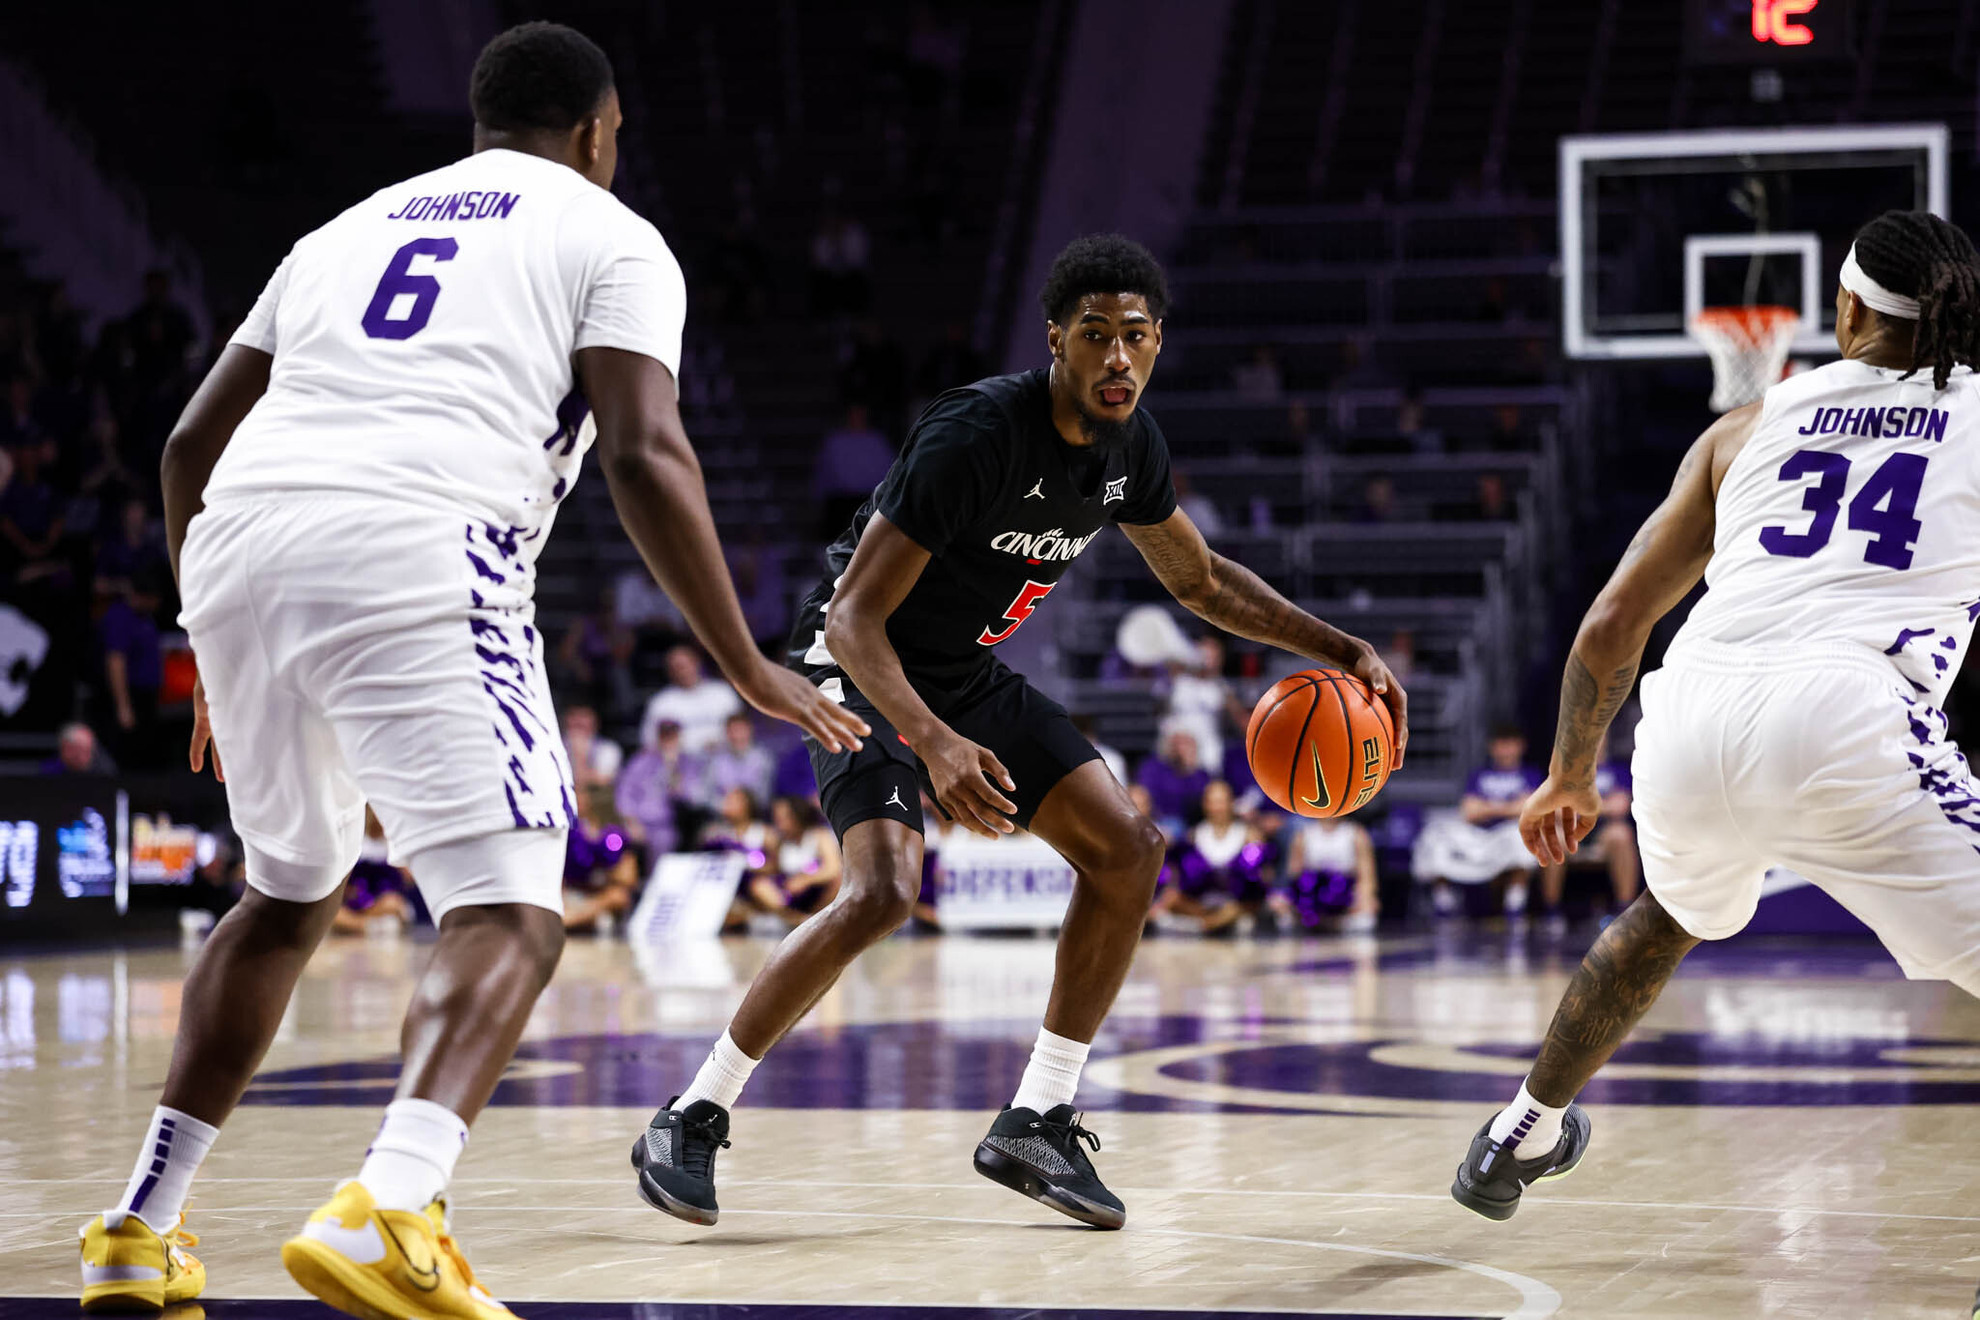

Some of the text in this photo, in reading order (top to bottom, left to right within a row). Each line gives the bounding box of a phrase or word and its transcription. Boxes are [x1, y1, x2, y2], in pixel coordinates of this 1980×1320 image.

[387, 191, 521, 221] JOHNSON
[361, 237, 459, 340] 6
[1798, 407, 1949, 443] JOHNSON
[1758, 450, 1930, 570] 34
[976, 579, 1058, 646] 5
[1352, 735, 1380, 808] ELITE
